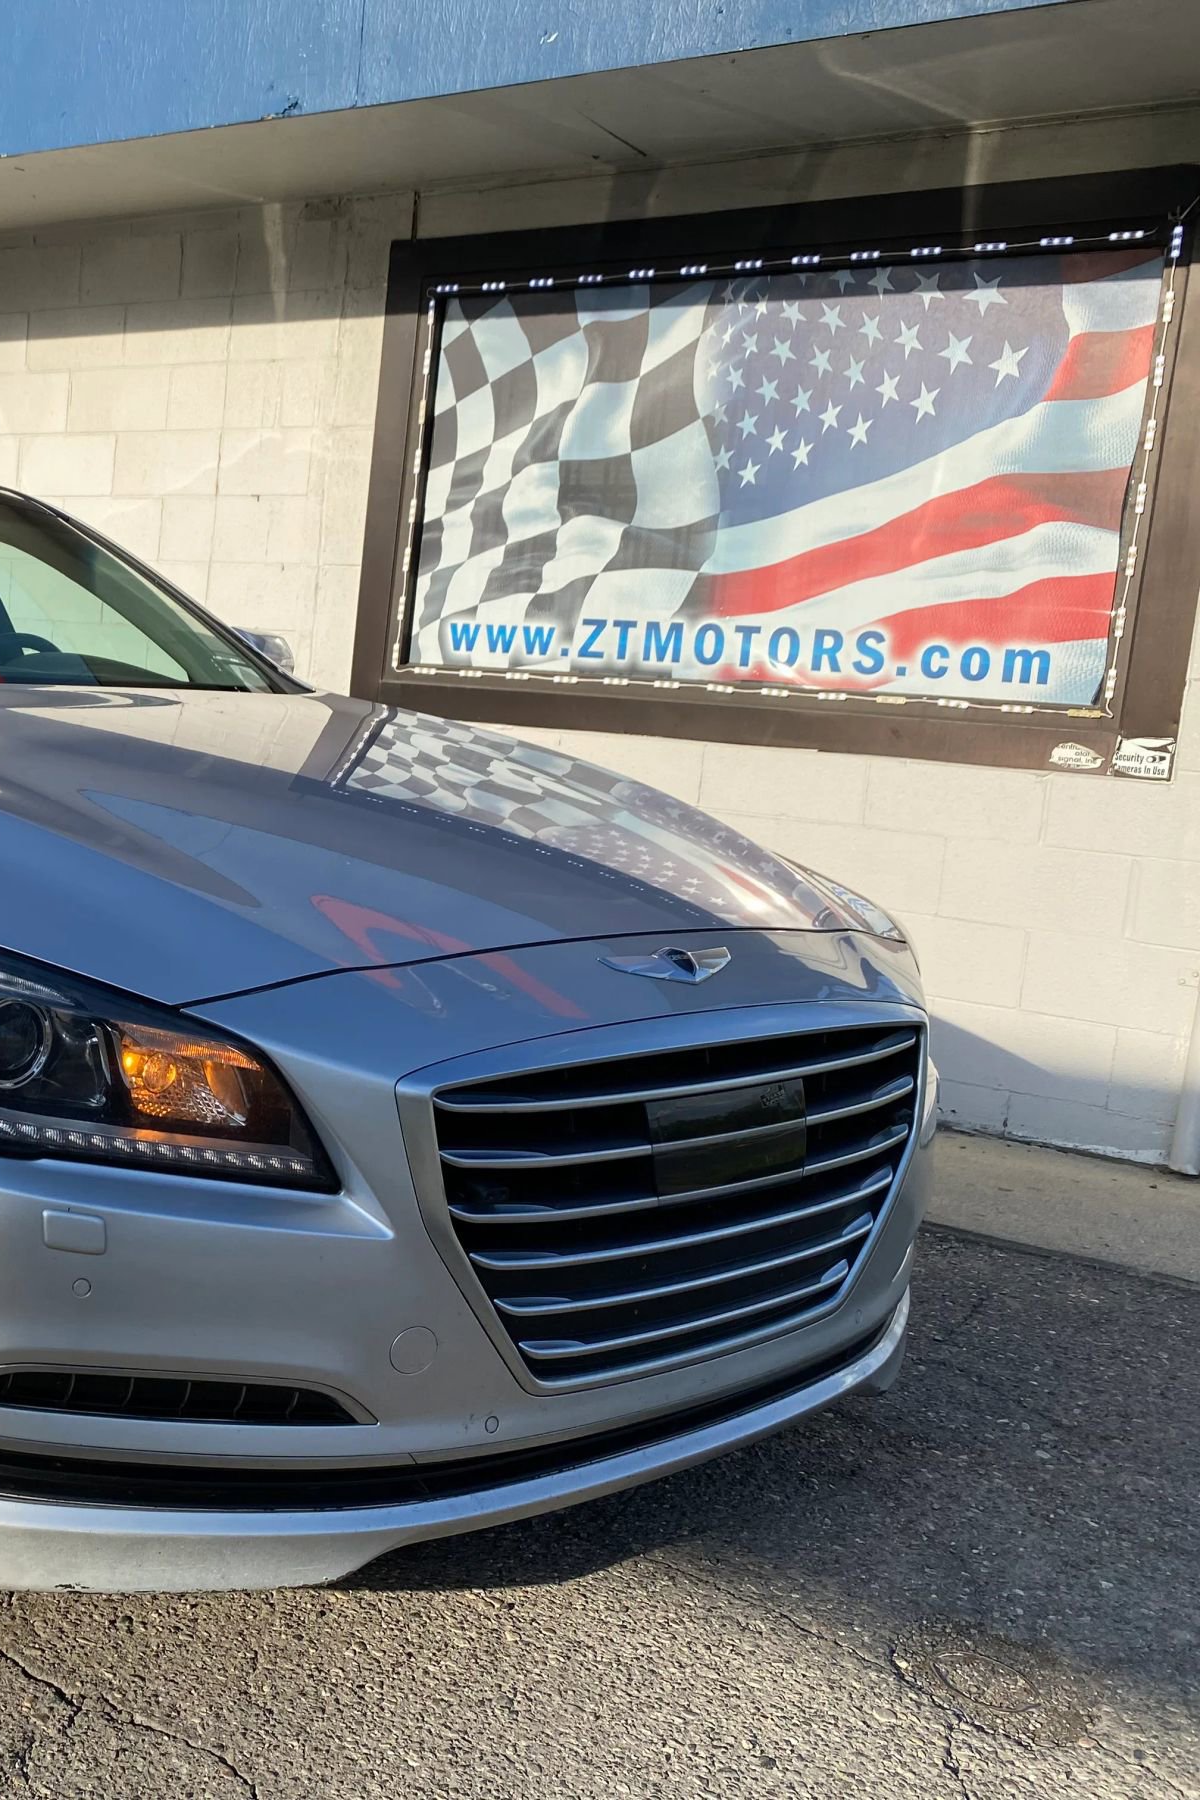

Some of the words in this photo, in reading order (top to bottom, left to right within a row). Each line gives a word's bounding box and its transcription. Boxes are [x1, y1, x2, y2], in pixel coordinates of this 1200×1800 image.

[449, 618, 1052, 684] www.ZTMOTORS.com
[1114, 751, 1145, 765] Security
[1143, 765, 1151, 775] In
[1152, 766, 1166, 776] Use
